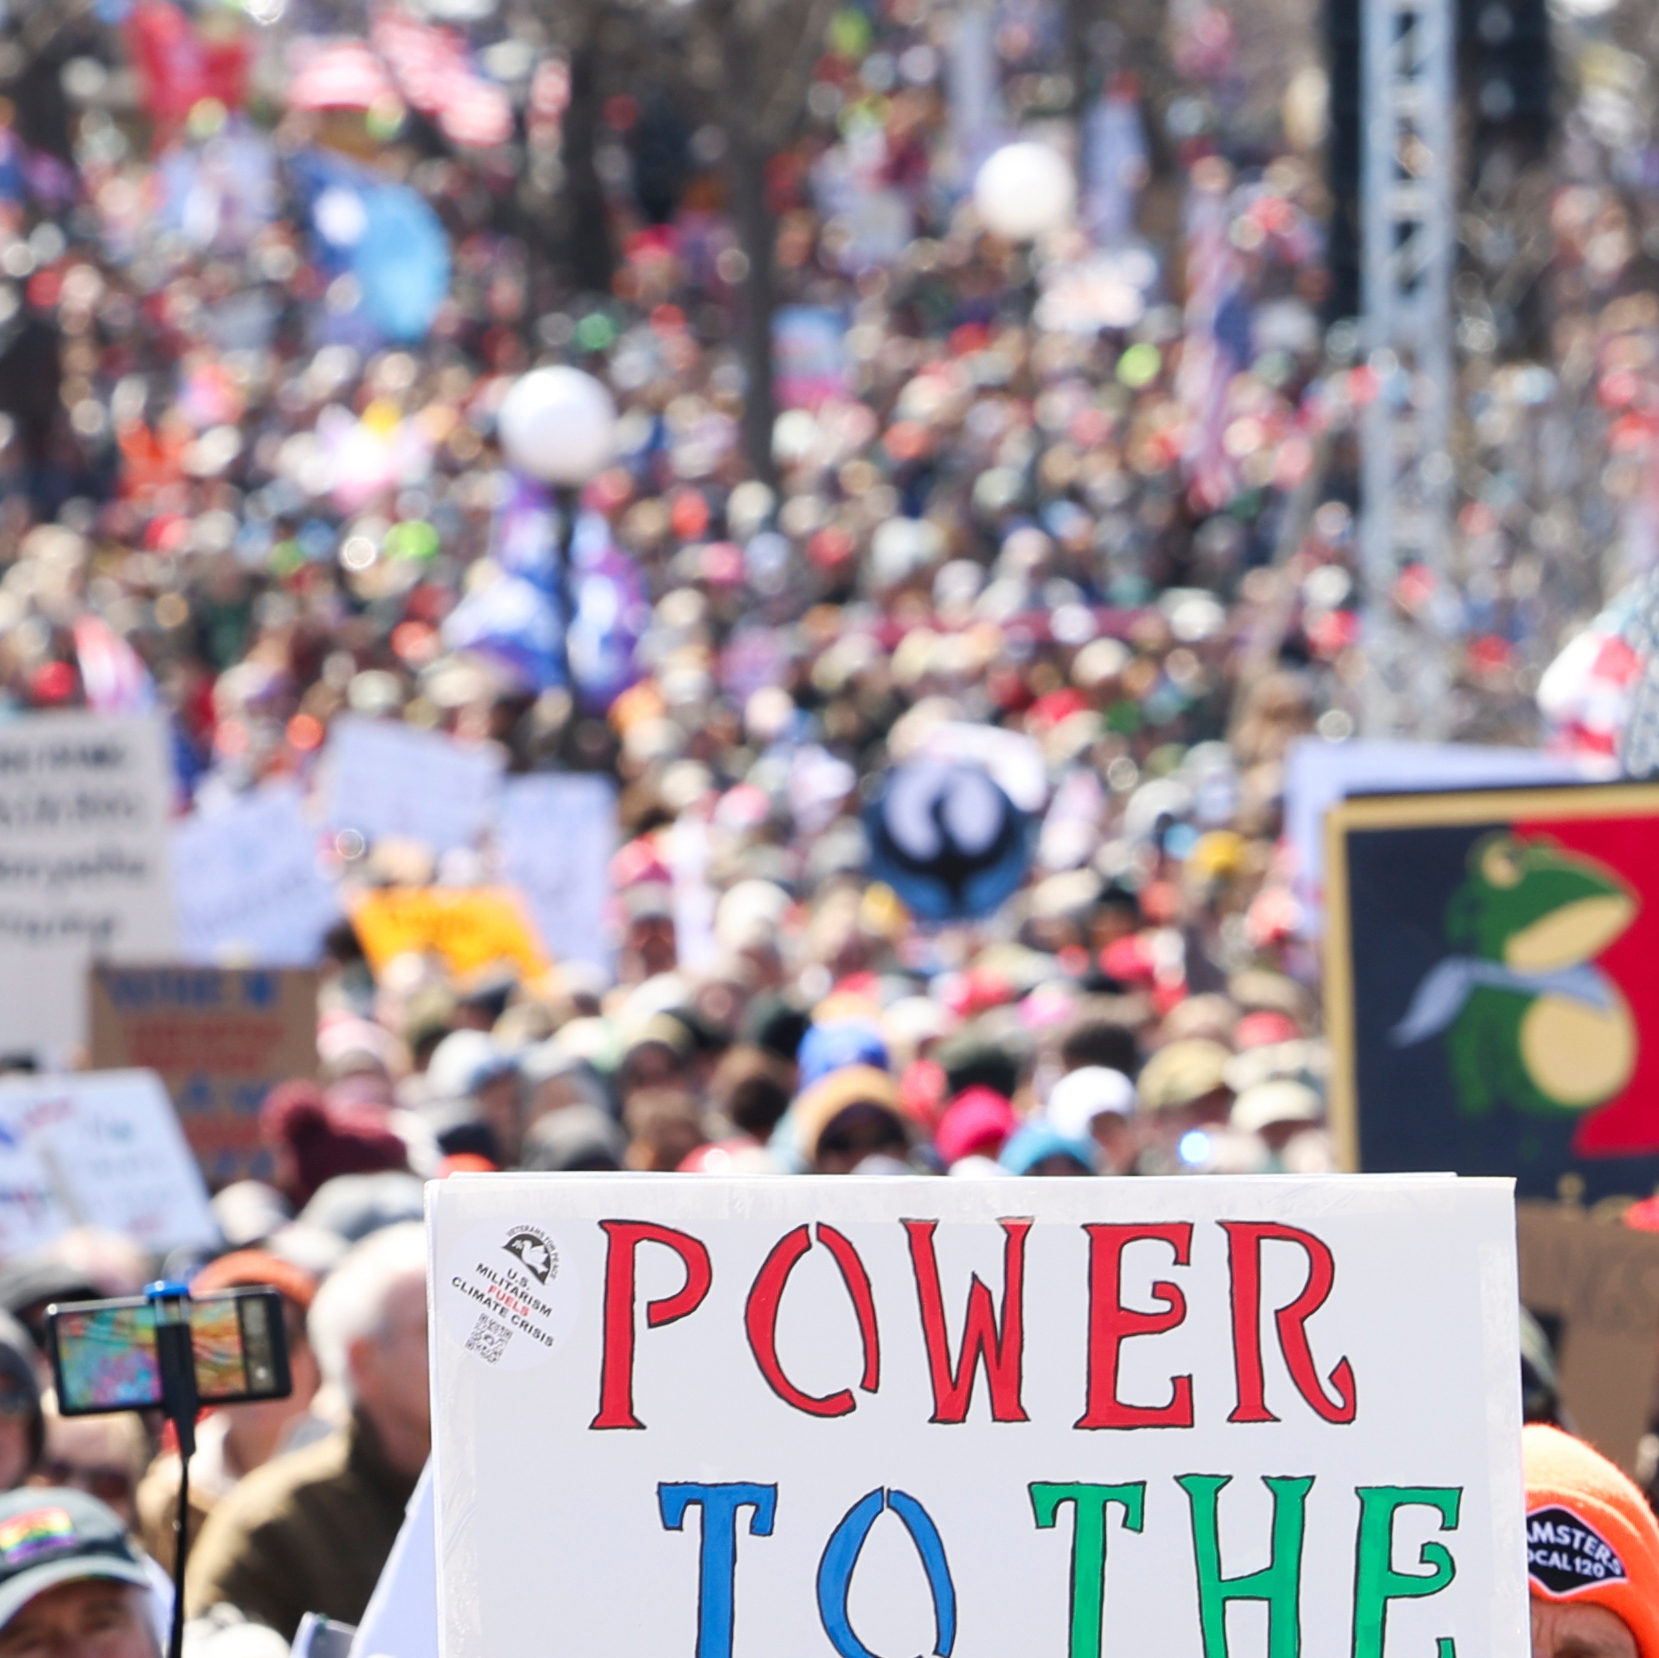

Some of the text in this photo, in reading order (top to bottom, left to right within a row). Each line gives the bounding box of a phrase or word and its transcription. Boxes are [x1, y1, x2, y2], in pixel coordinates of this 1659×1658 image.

[506, 1224, 545, 1238] VETERANS
[475, 1263, 553, 1318] MILITARISM
[506, 1268, 531, 1290] U.S.
[451, 1276, 555, 1347] CLIMATE CRISIS
[488, 1284, 530, 1317] FUELS
[589, 1217, 1356, 1430] POWER
[1574, 1556, 1605, 1578] 120
